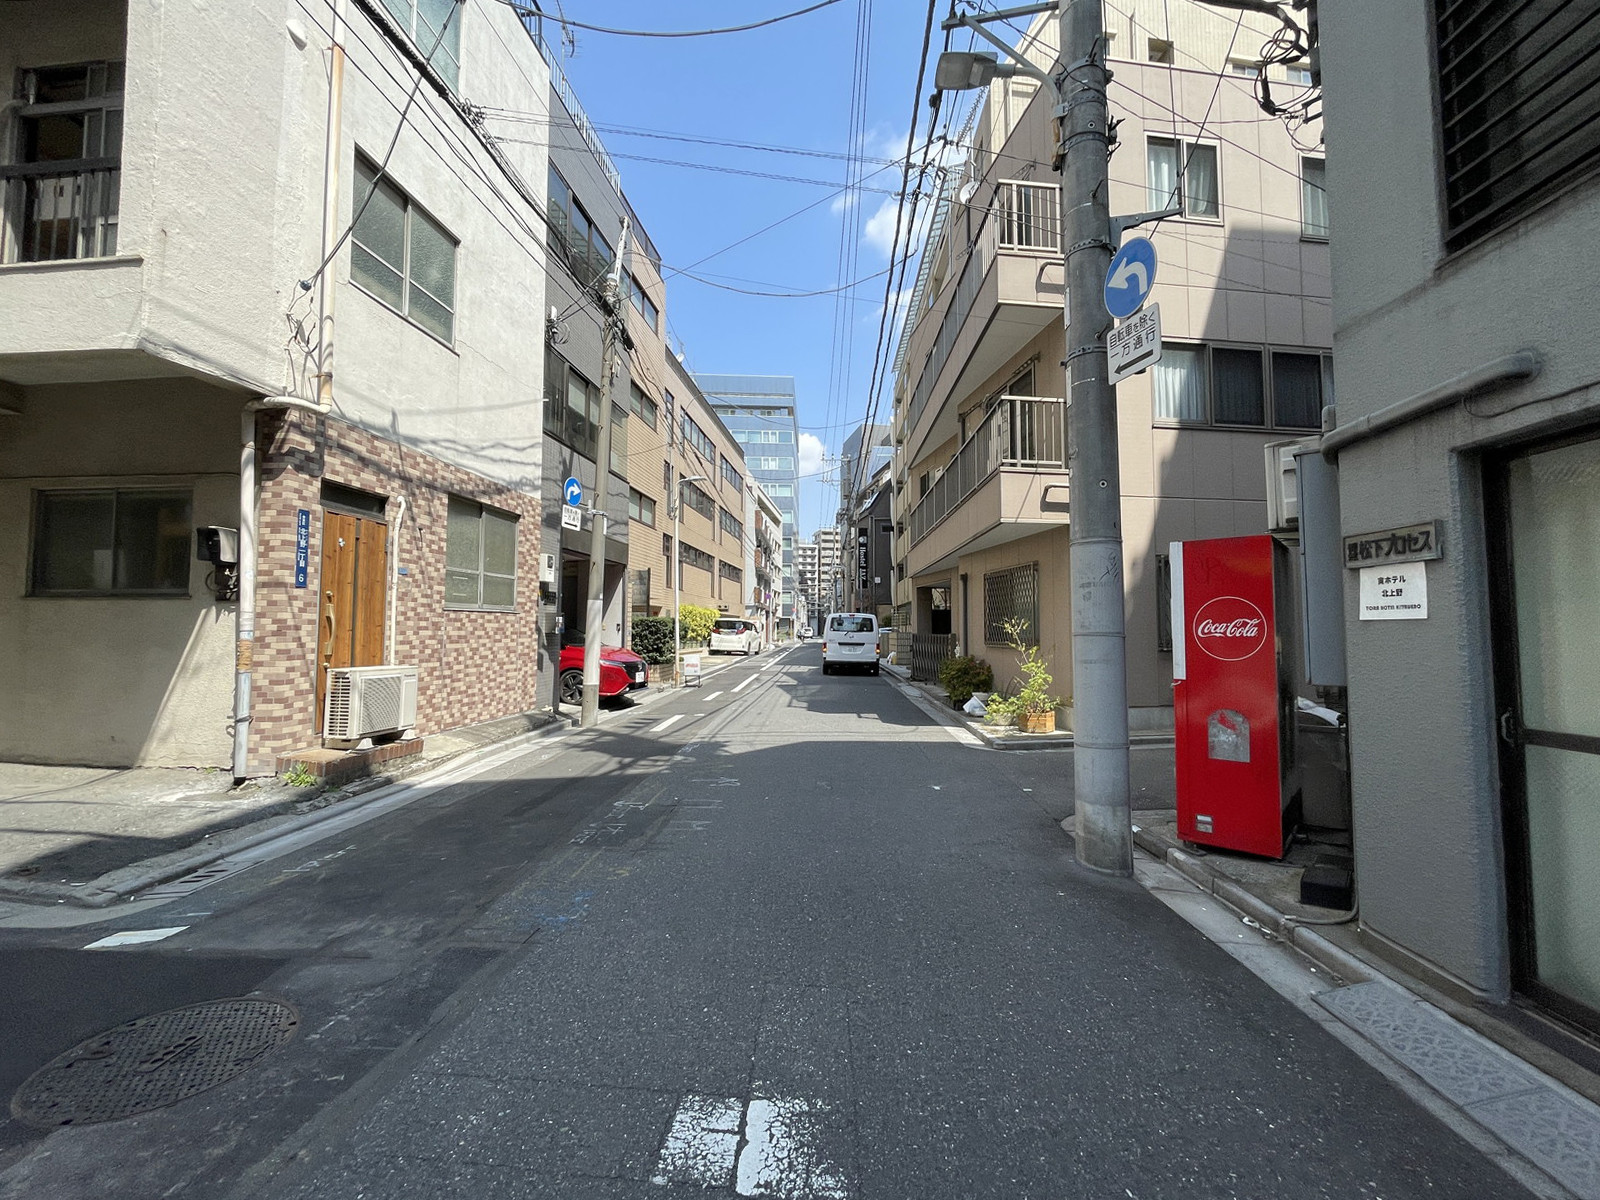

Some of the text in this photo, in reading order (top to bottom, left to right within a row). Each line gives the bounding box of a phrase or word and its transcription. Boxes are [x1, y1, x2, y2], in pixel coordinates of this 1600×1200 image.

[1110, 311, 1155, 347] 自転車を除く
[1110, 326, 1156, 358] 一方通行
[298, 574, 304, 582] 6
[1381, 588, 1403, 597] 北上野
[1198, 618, 1262, 637] Coca-Cola
